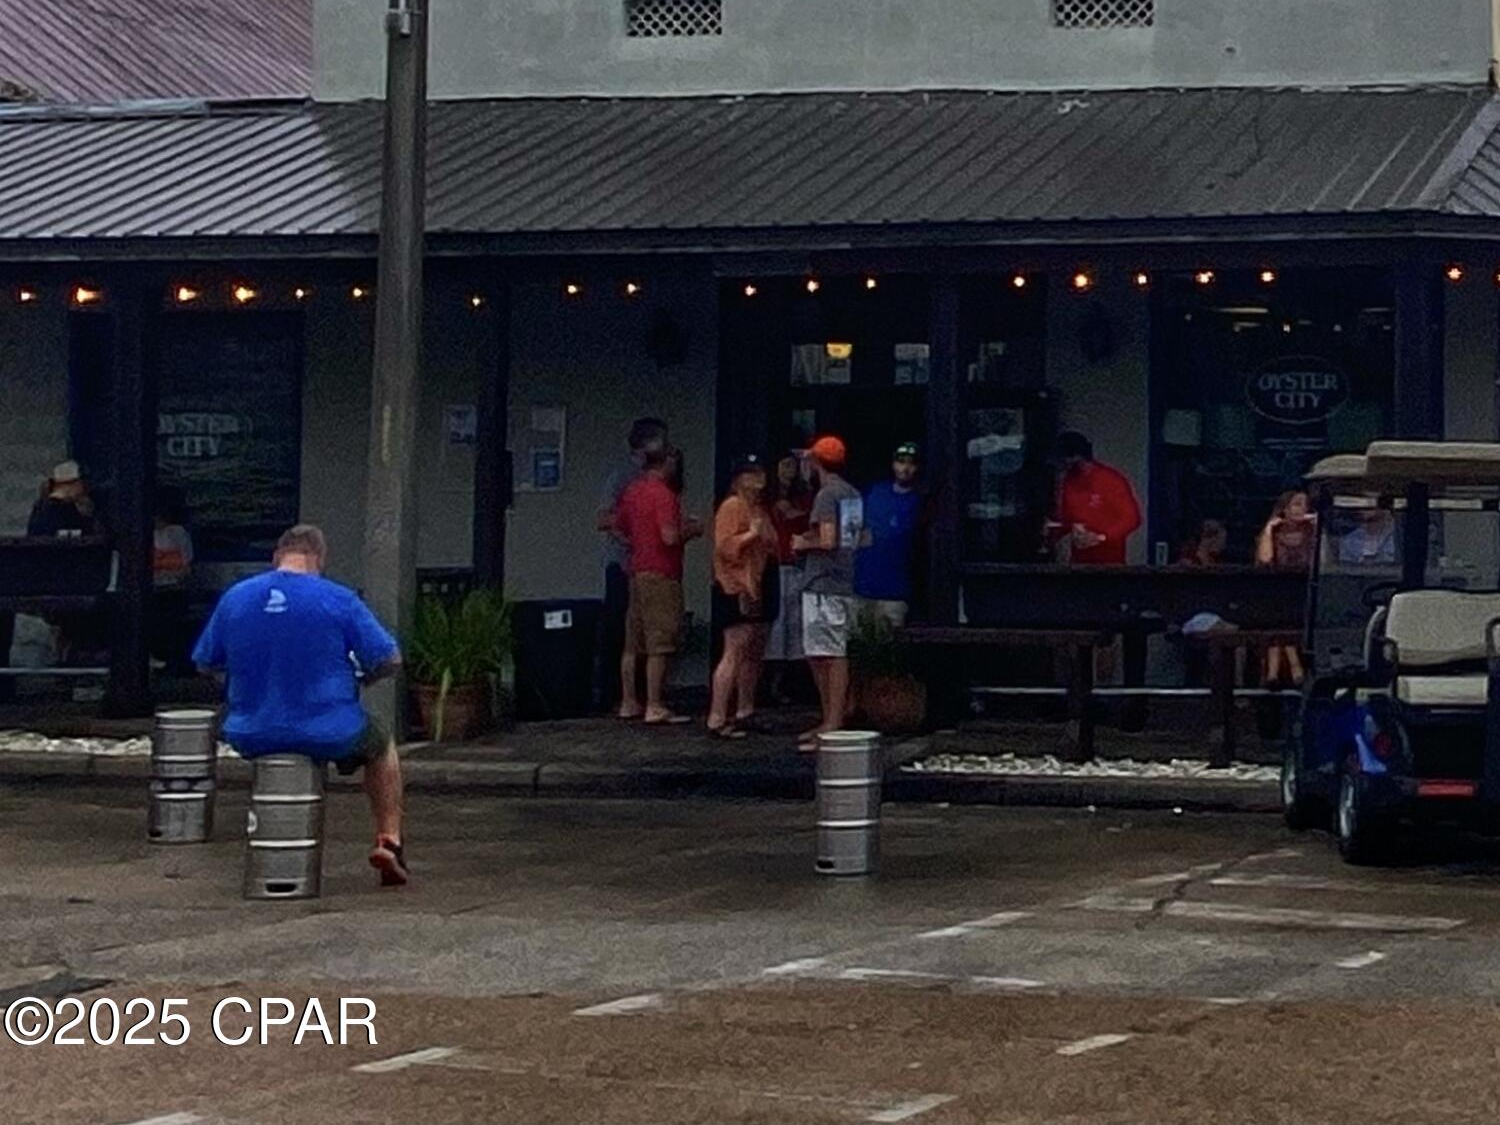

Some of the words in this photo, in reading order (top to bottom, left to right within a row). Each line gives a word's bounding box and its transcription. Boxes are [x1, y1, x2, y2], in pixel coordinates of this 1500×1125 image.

[1258, 372, 1338, 391] OYSTER
[1275, 391, 1321, 408] CITY
[167, 435, 222, 457] CITY
